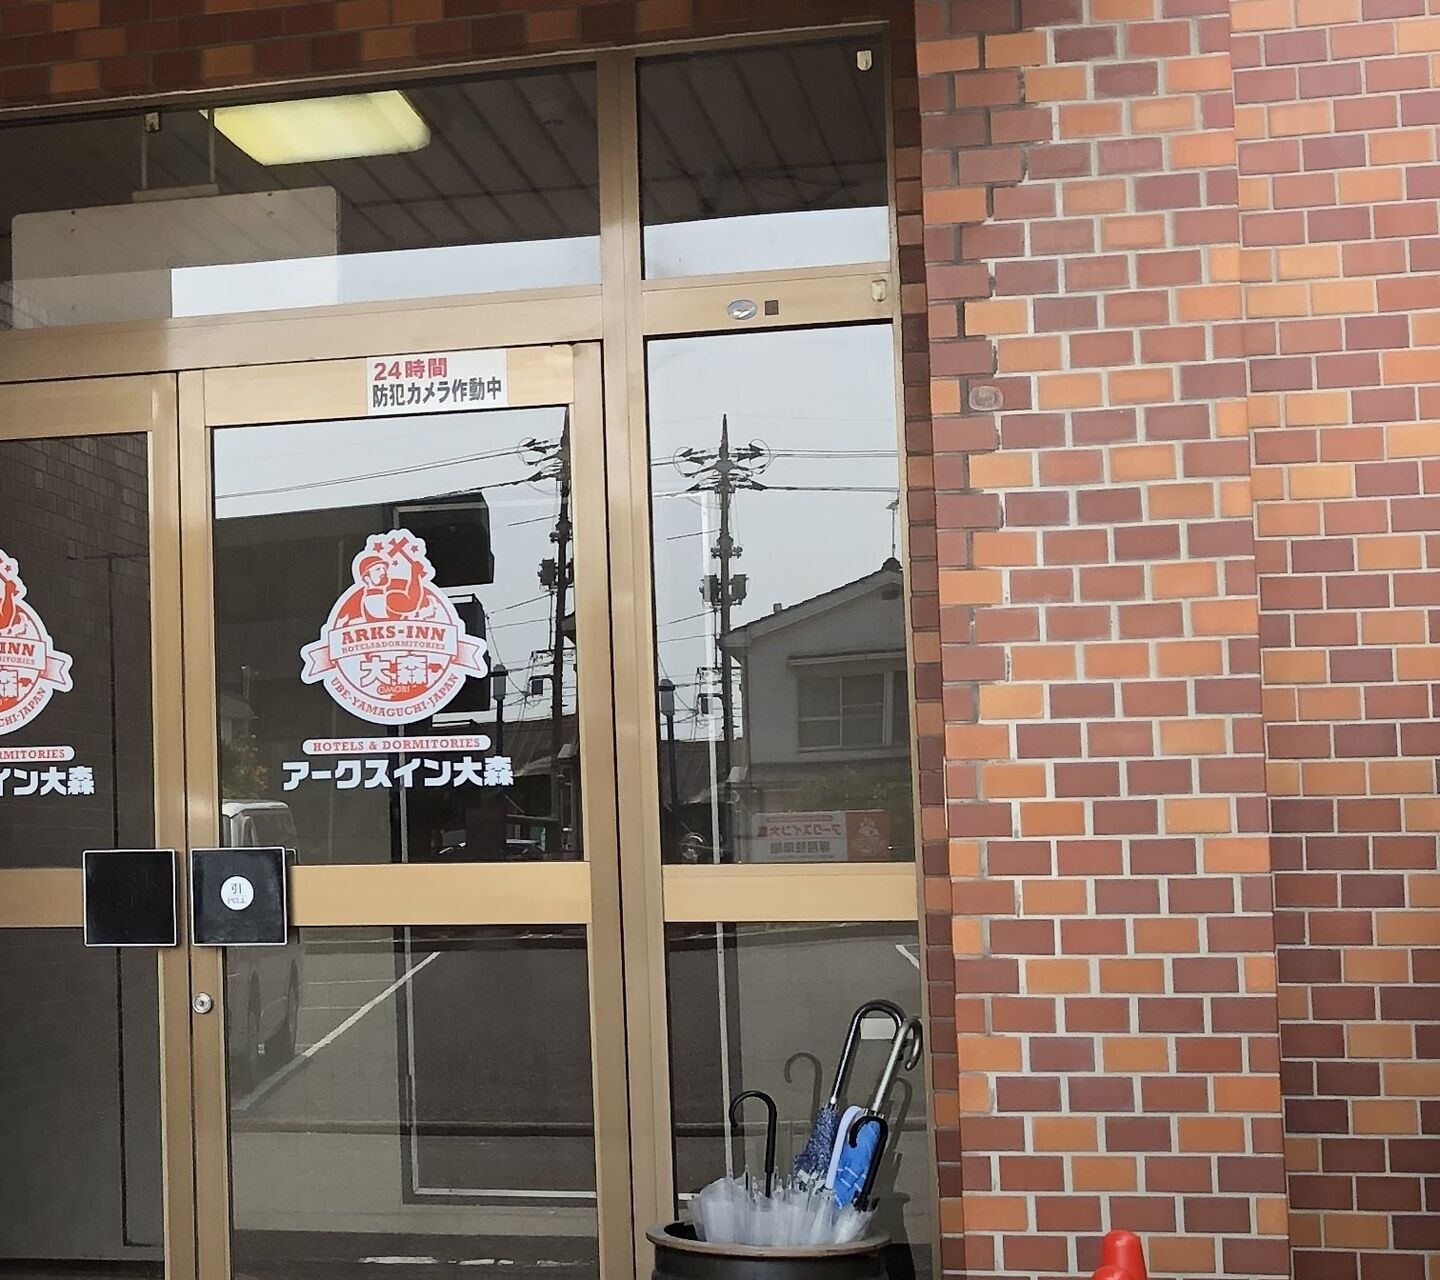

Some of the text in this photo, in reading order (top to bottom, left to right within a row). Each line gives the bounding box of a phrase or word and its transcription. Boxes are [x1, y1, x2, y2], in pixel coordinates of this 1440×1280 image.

[373, 357, 448, 382] 24時間
[372, 376, 502, 408] 防犯カメラ作動中
[341, 625, 446, 645] ARKS-INN
[360, 655, 428, 687] 大森
[313, 737, 481, 752] HOTELS & DORMITORIES
[282, 755, 514, 790] アークスイン大森
[231, 883, 242, 895] 引
